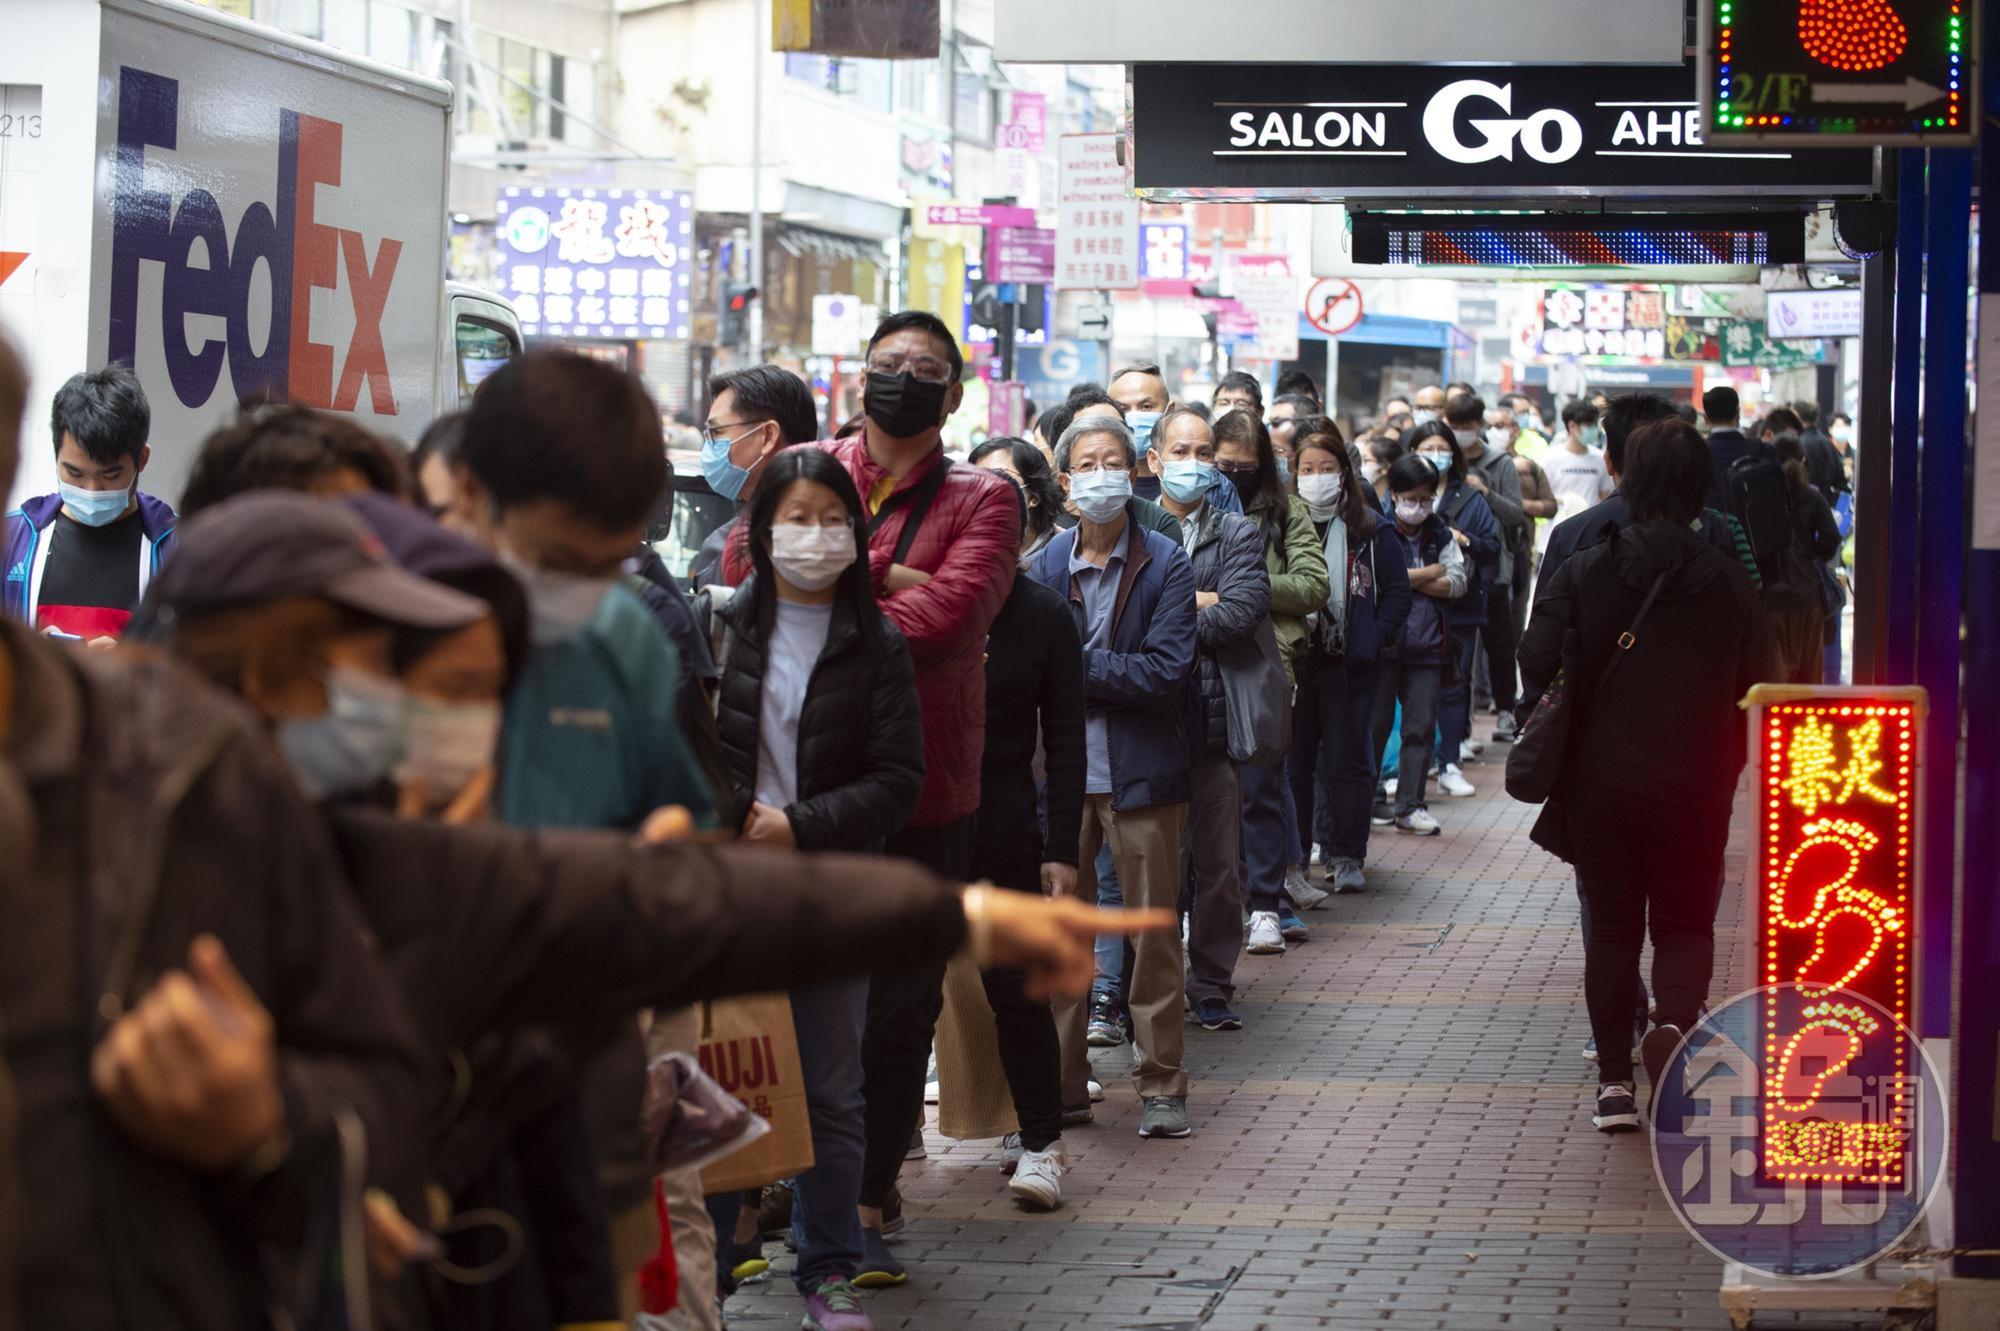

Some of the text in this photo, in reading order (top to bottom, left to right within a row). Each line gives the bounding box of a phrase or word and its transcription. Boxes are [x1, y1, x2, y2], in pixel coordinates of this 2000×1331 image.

[1229, 111, 1387, 148] SALON
[1422, 78, 1584, 165] Go
[1731, 72, 1808, 114] 2/F
[108, 65, 404, 416] FedEx
